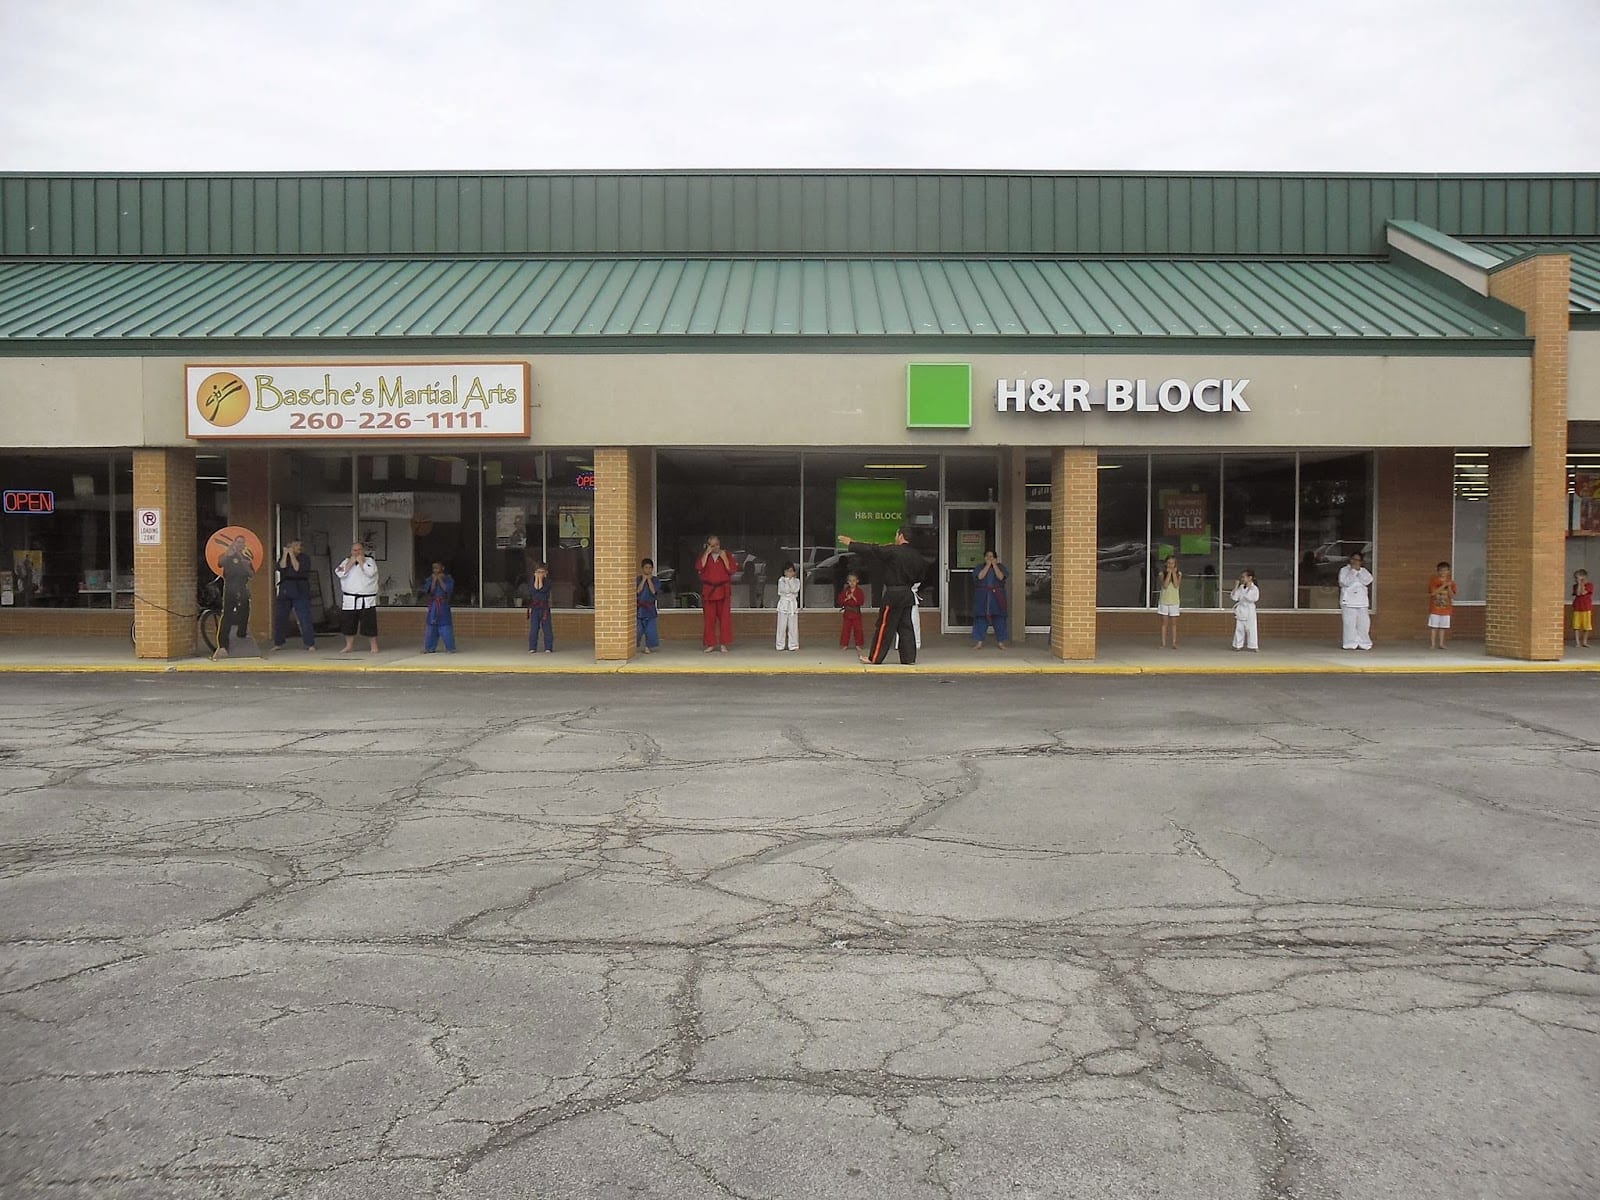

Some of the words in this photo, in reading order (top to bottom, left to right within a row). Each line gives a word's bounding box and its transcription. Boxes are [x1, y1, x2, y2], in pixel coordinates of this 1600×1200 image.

[254, 373, 375, 412] Basche's
[378, 374, 458, 409] Martial
[461, 376, 517, 410] Arts
[996, 378, 1092, 413] H&R
[1106, 378, 1251, 413] BLOCK
[289, 411, 483, 430] 260-226-1111
[576, 475, 595, 487] OPE
[5, 492, 52, 511] OPEN
[855, 511, 873, 520] H&R
[874, 511, 902, 520] BLOCK
